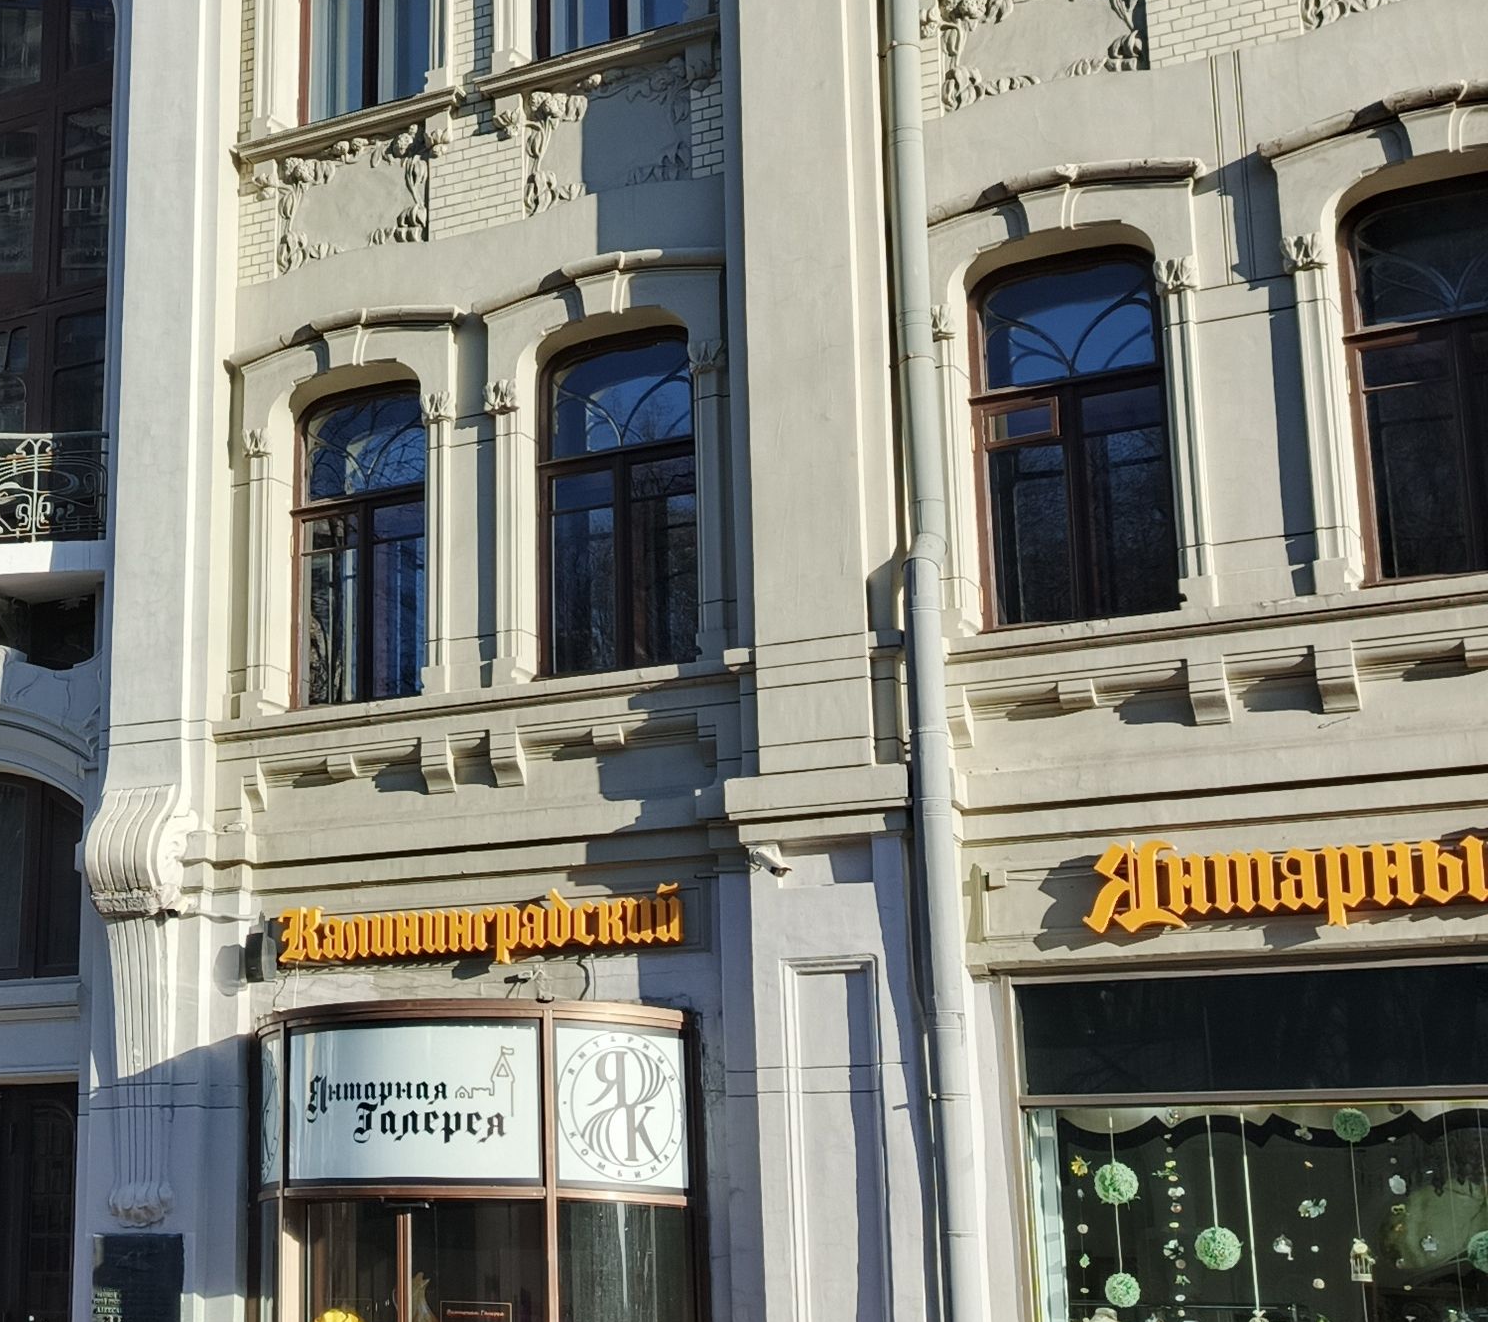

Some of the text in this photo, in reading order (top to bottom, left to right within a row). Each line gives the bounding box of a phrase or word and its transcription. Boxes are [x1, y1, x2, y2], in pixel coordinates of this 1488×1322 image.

[278, 882, 684, 965] Калининградский
[305, 1074, 448, 1123] Янтарная
[353, 1102, 507, 1143] Галерея
